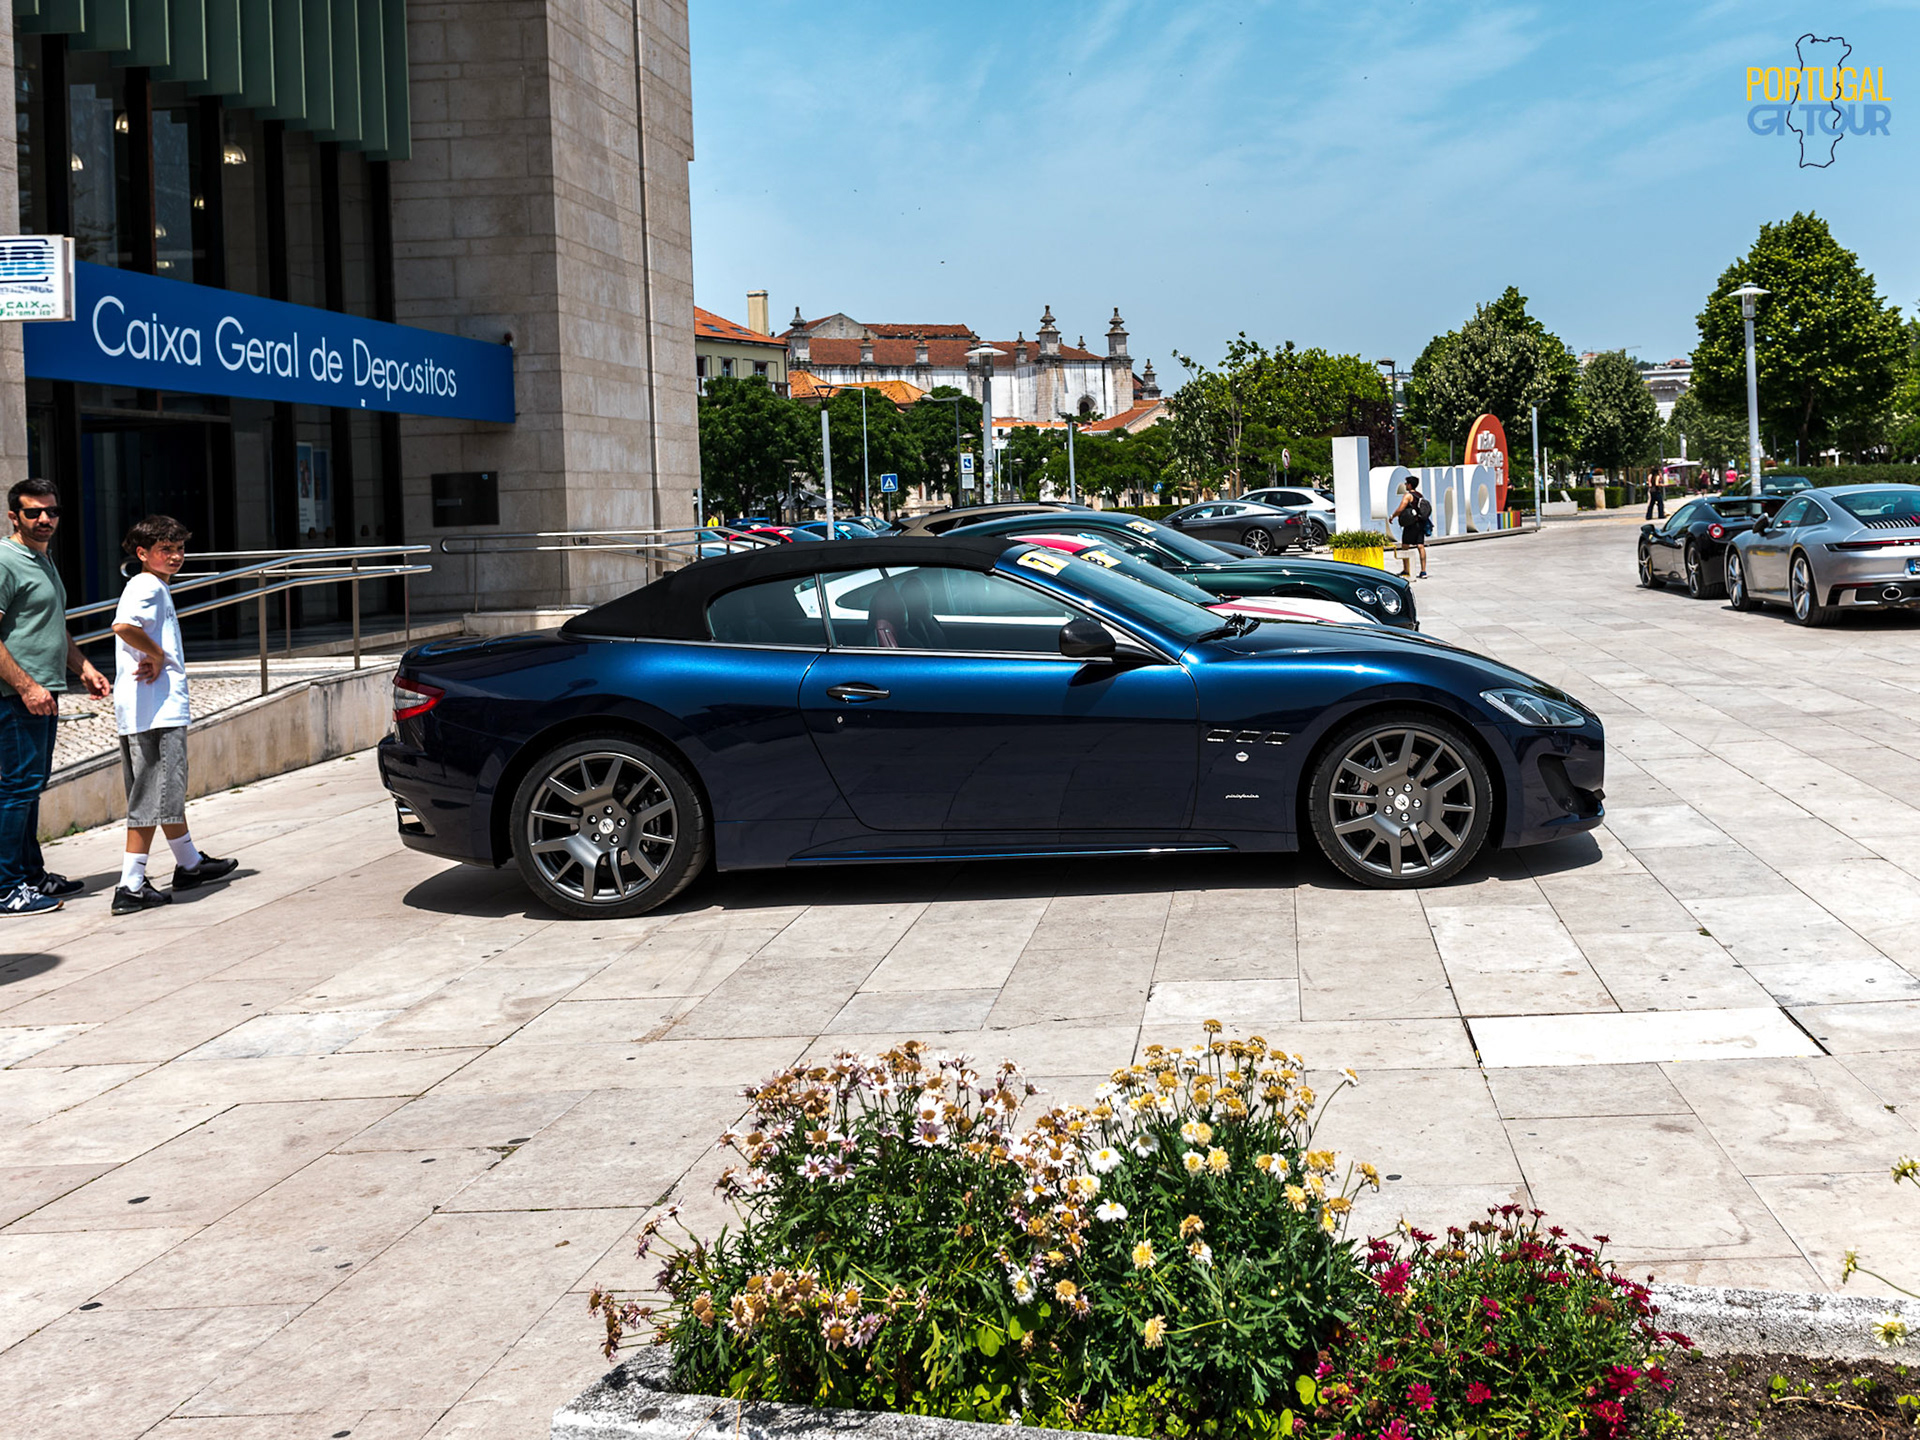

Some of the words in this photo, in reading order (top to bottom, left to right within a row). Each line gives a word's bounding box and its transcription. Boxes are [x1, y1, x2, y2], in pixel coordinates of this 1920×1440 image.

[92, 295, 202, 366] Caixa
[215, 316, 299, 378] Geral
[309, 336, 343, 383] de
[42, 881, 58, 894] N
[7, 897, 26, 911] N
